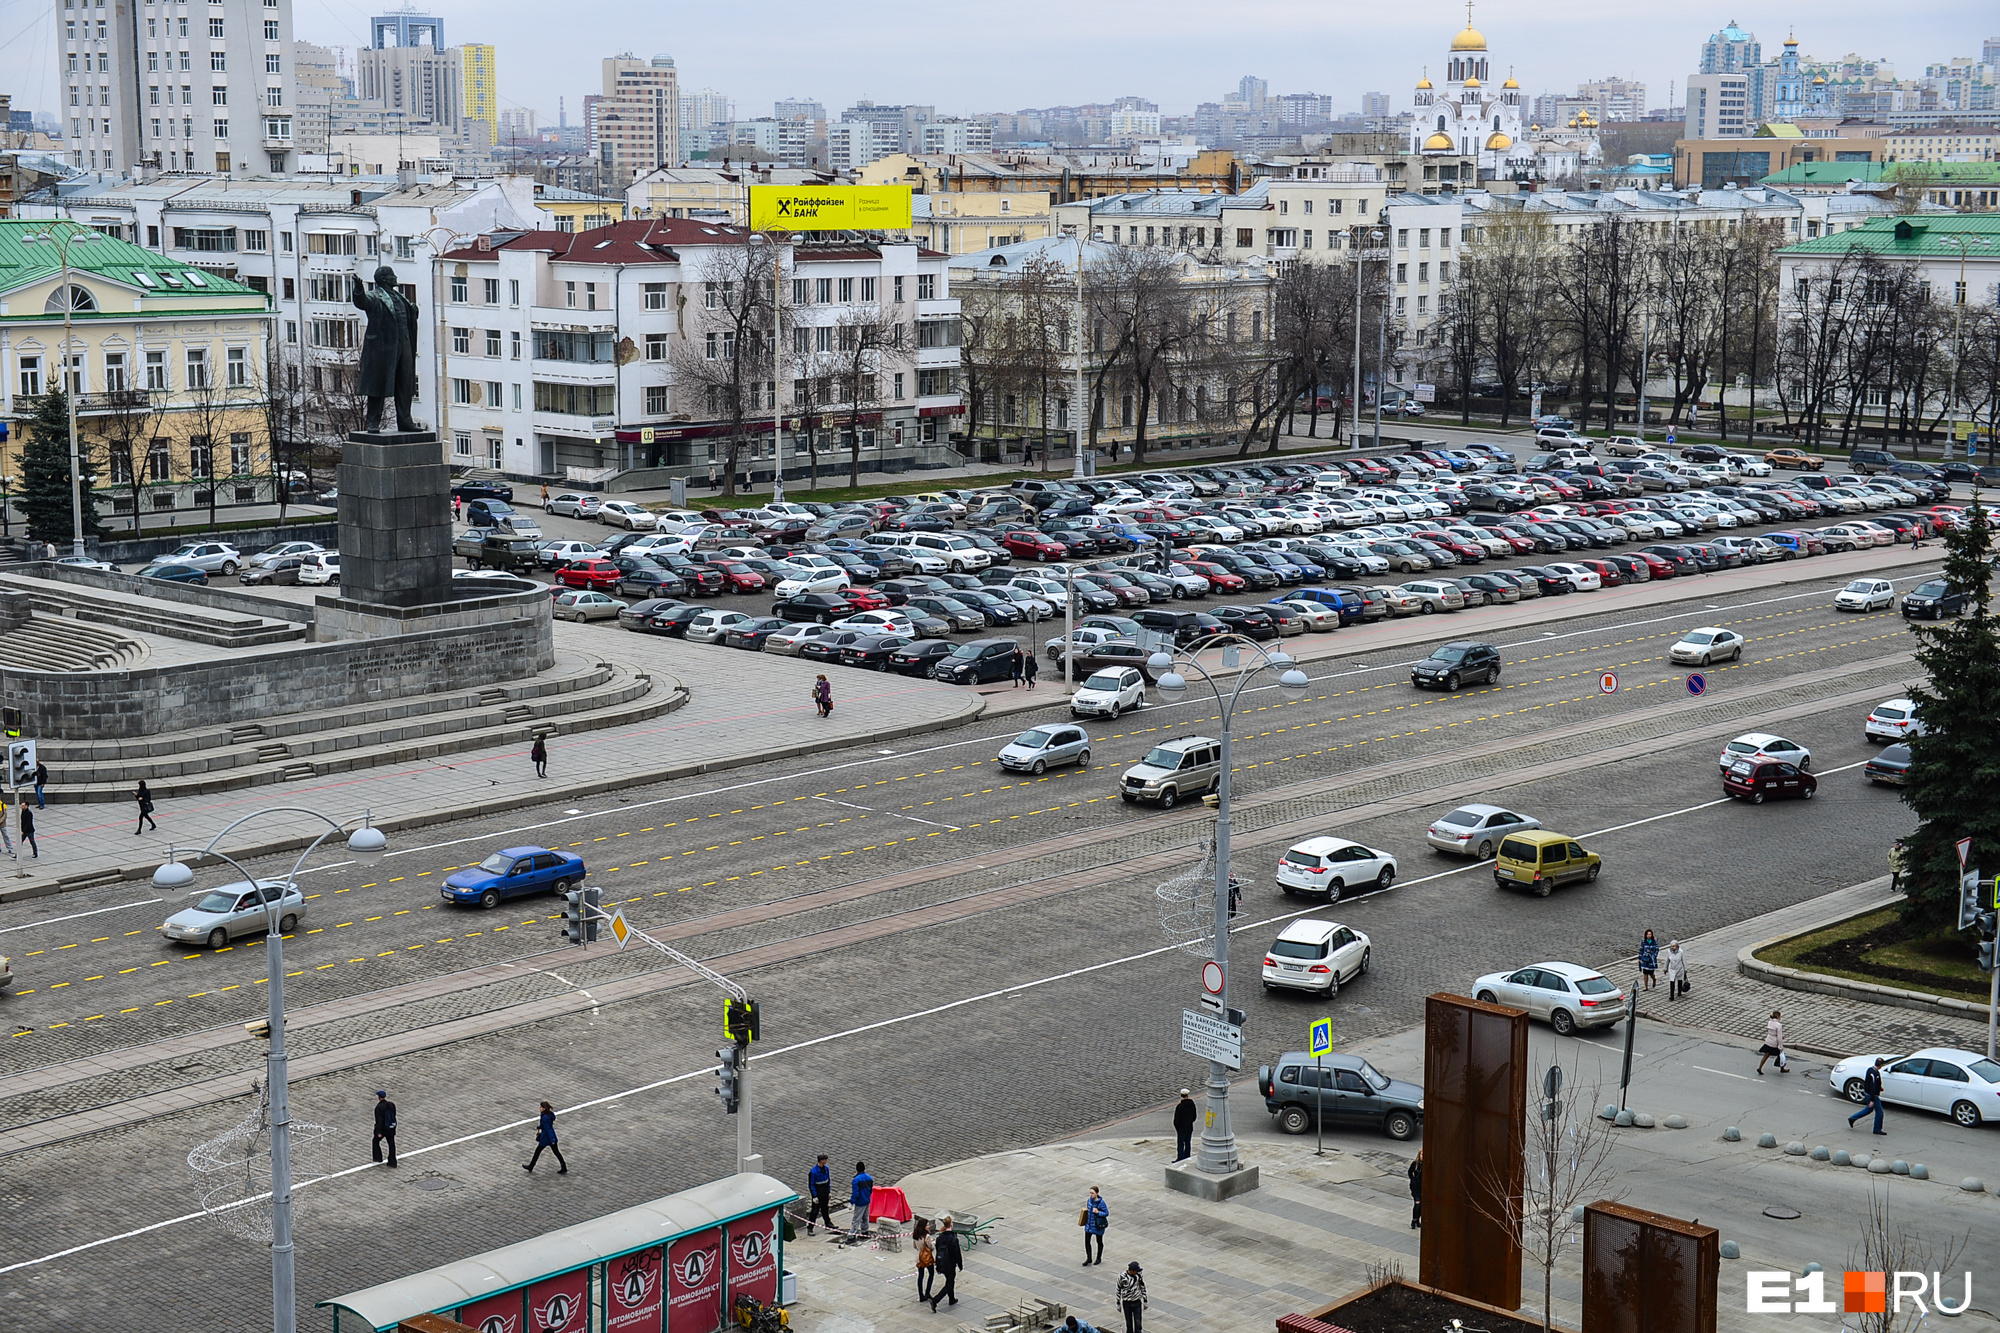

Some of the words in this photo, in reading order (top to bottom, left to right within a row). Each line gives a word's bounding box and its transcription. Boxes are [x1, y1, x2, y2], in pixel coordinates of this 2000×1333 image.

[794, 197, 844, 208] Райффайзен
[794, 208, 818, 217] БАНК
[1184, 1019, 1214, 1034] BANKOVSKY
[1216, 1030, 1229, 1039] LANE
[1196, 1016, 1230, 1031] БАНКОВСКИЙ
[1184, 1029, 1218, 1044] АДМИНИСТРАЦИЯ
[1184, 1034, 1199, 1043] ГОРОДА
[1200, 1039, 1232, 1054] ЕКАТЕРИНБУРГА
[1184, 1044, 1216, 1059] ADMINISTRATION
[728, 1264, 777, 1285] АВТОМОБИЛИСТ
[759, 1272, 769, 1282] клуб
[669, 1283, 720, 1306] АВТОМОБИЛИСТ
[703, 1292, 712, 1302] клуб
[608, 1303, 661, 1326] АВТОМОБИЛИСТ
[641, 1313, 652, 1321] клуб
